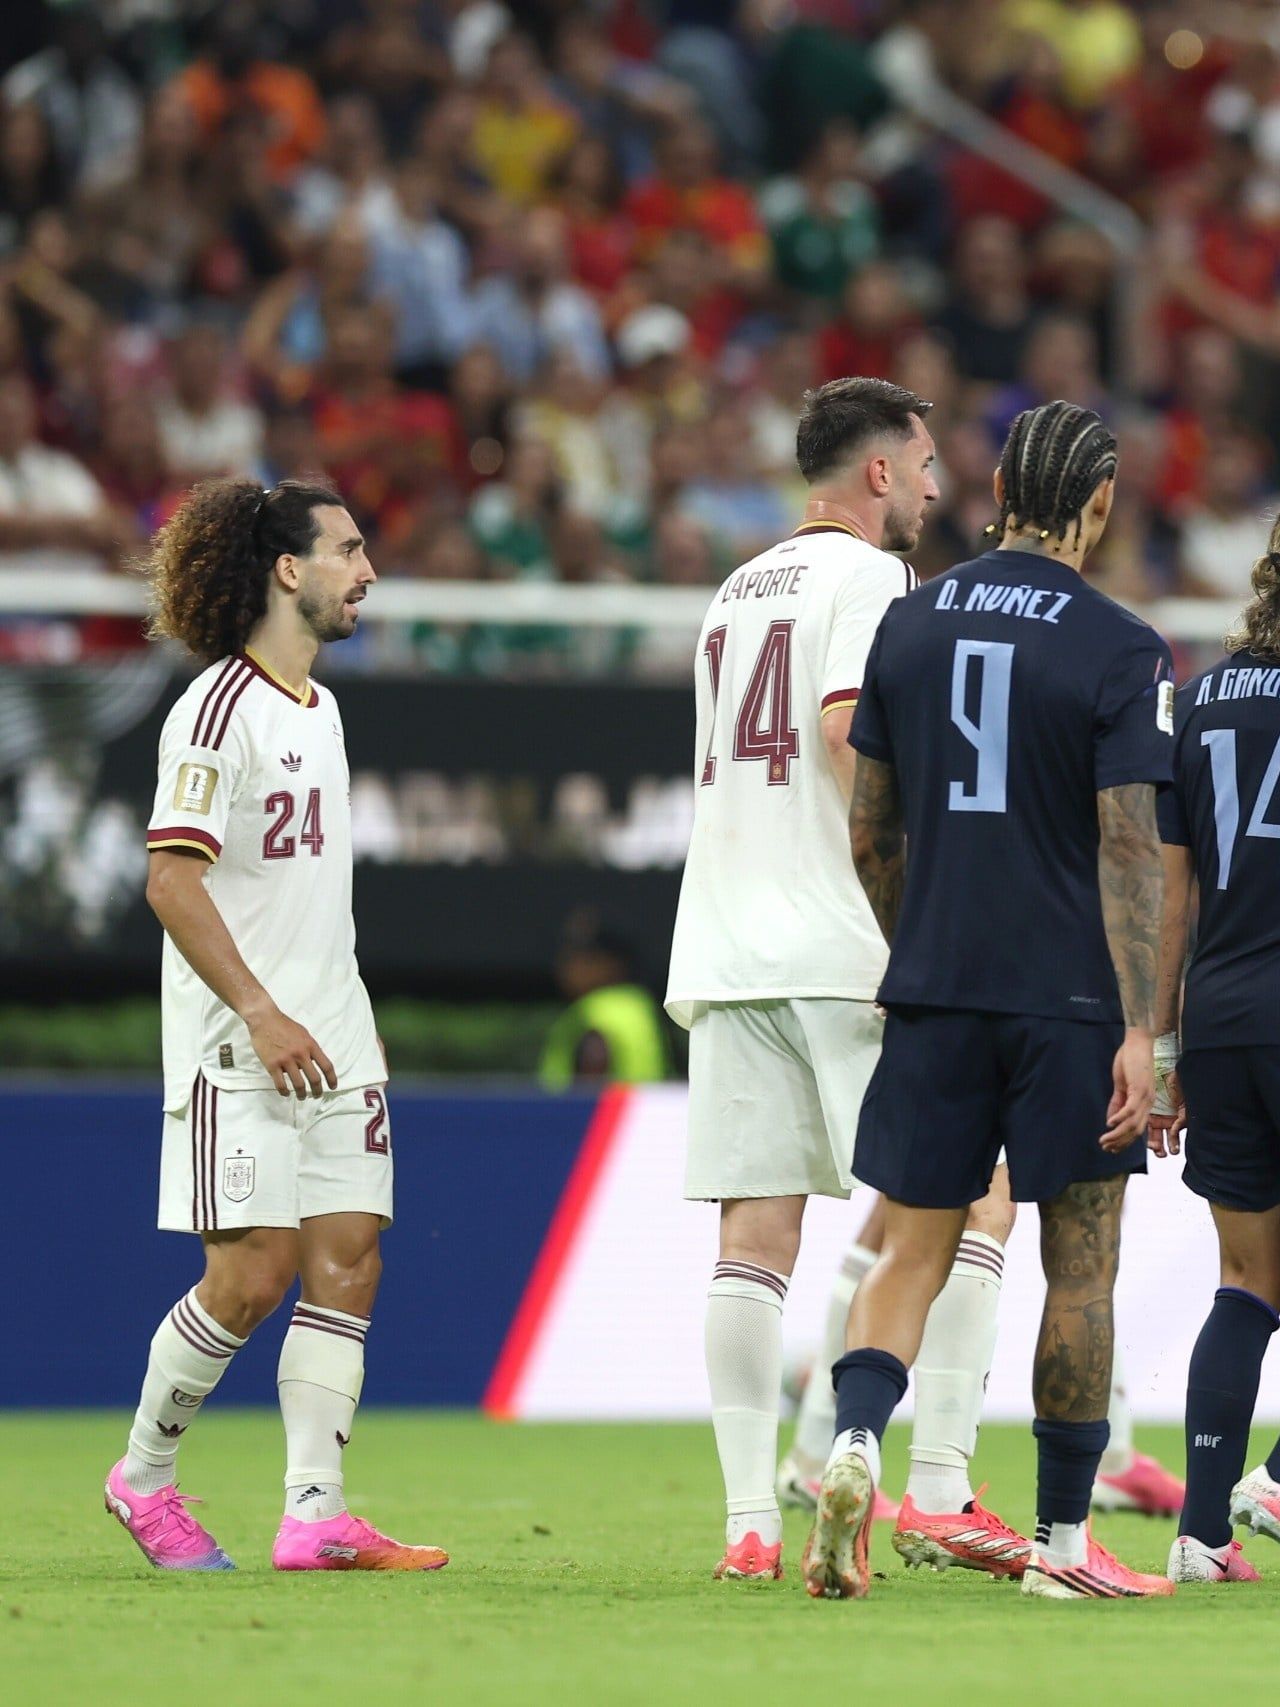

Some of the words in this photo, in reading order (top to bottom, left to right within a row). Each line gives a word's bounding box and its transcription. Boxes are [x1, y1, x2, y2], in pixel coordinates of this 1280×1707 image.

[722, 565, 809, 604] LAPORTE
[964, 584, 1072, 624] NUÑEZ
[700, 619, 800, 787] 14
[948, 638, 1016, 813] 9
[262, 787, 325, 861] 24
[1194, 1433, 1223, 1449] AUF
